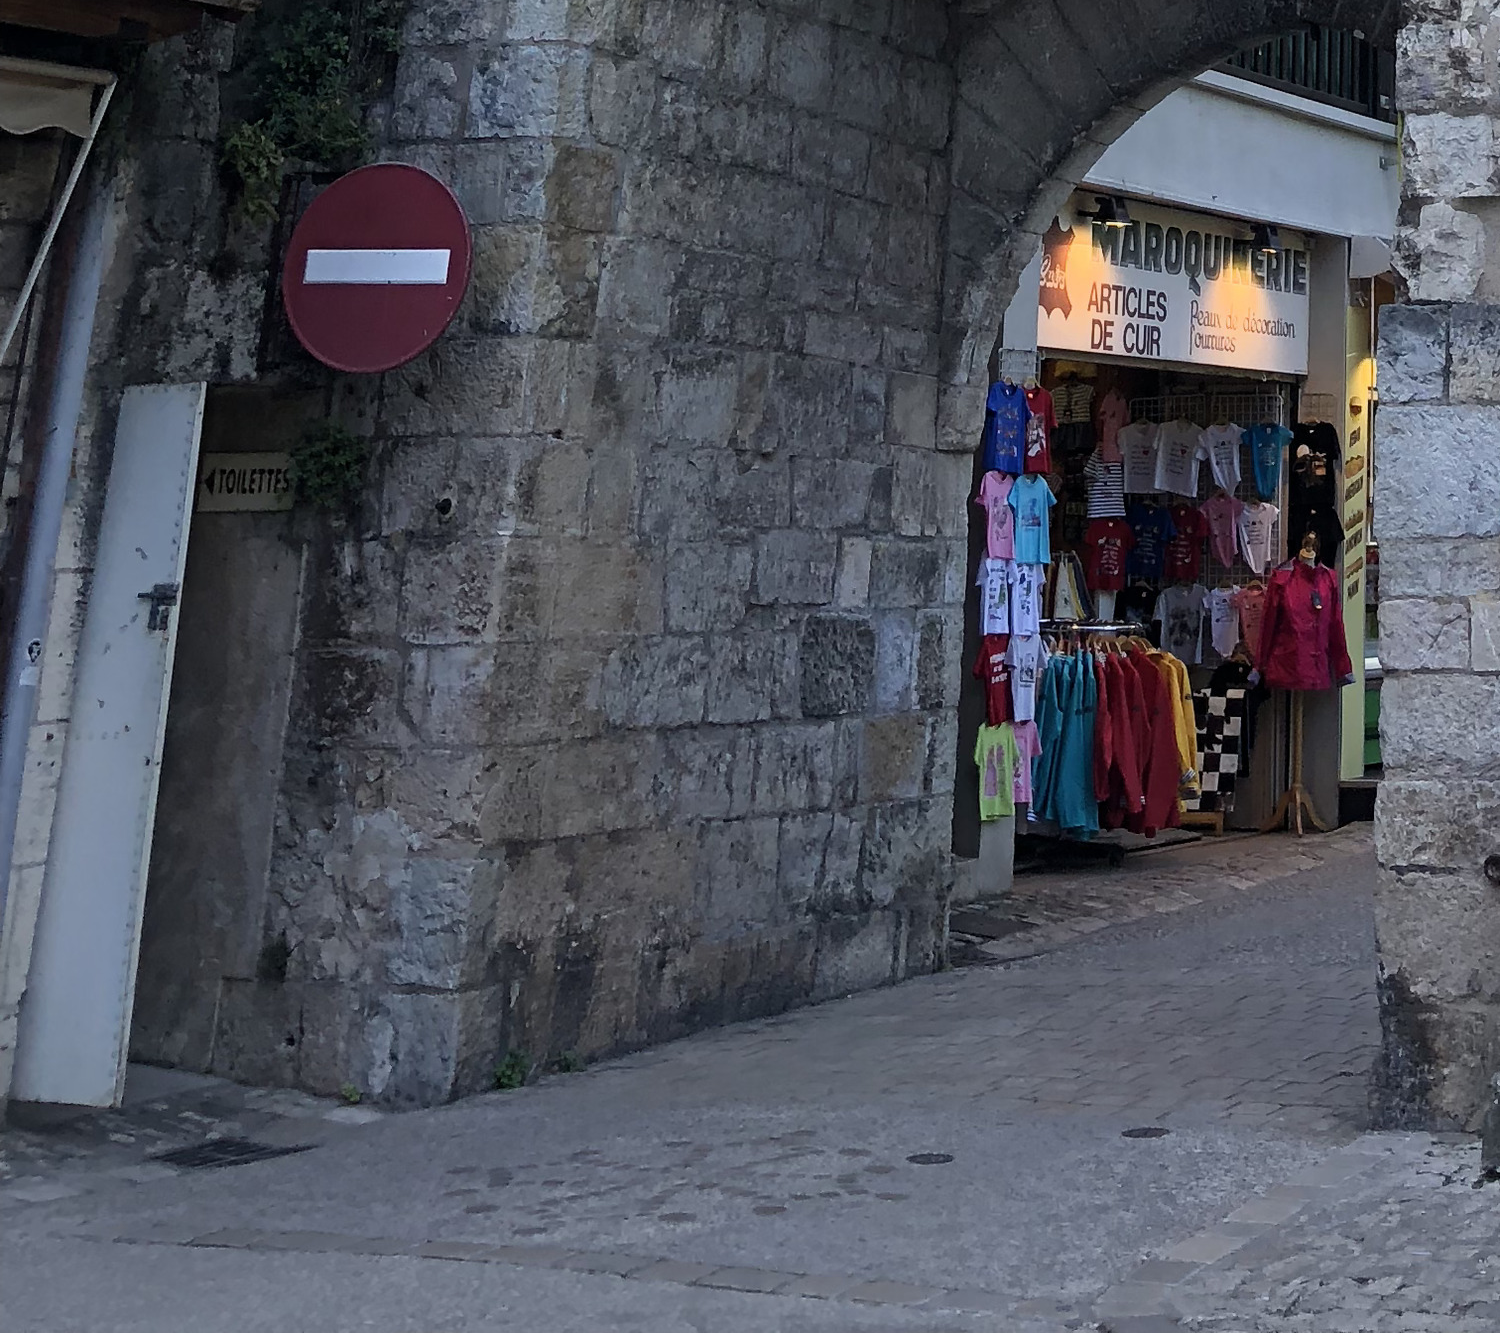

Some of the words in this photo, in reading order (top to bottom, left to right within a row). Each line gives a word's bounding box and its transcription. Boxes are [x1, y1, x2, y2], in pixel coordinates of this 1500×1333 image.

[1091, 217, 1307, 296] MAROQUINERIE
[1087, 282, 1168, 322] ARTICLES
[1190, 300, 1222, 329] Peaux
[1225, 304, 1237, 330] de
[1243, 307, 1296, 338] décoration
[1091, 319, 1115, 351] DE
[1123, 323, 1161, 357] CUIR
[219, 468, 289, 494] TOILETTES
